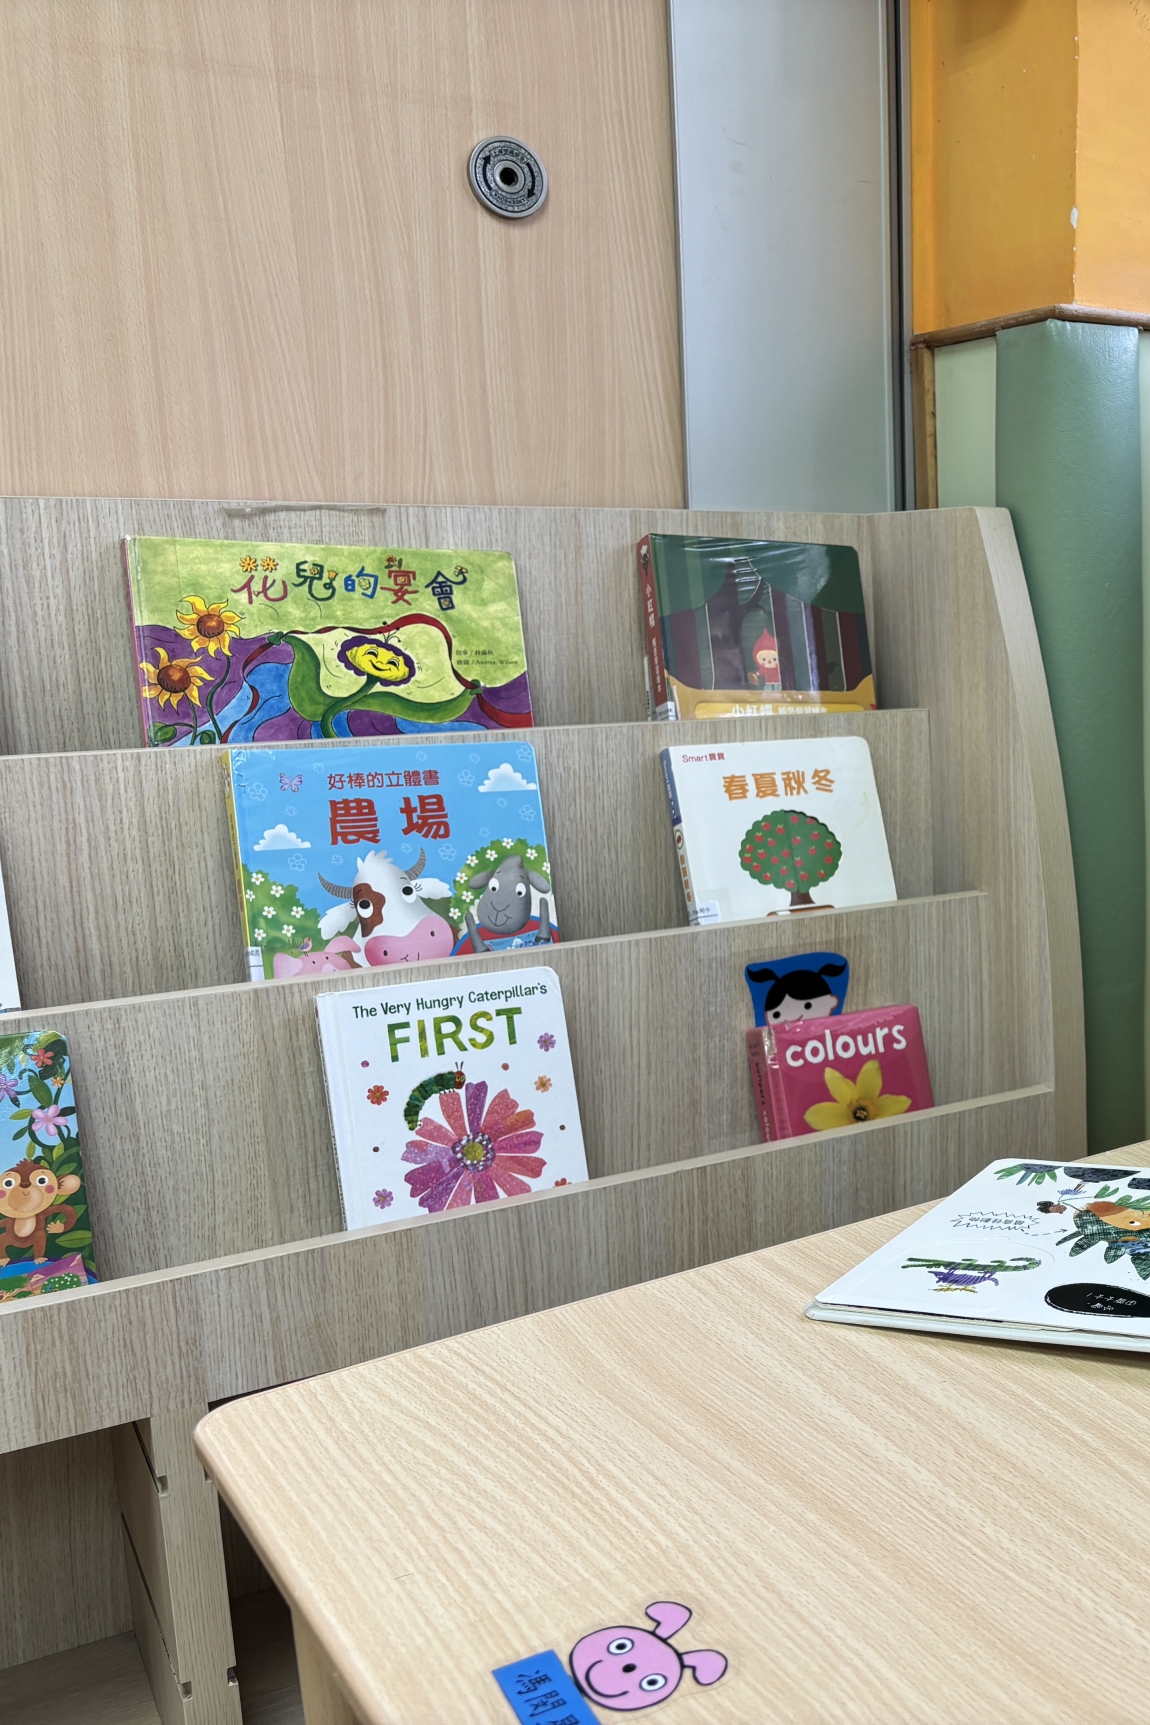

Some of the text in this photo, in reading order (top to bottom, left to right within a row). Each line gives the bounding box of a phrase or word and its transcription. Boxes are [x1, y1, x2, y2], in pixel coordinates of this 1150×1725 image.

[230, 555, 468, 611] 花兒的宴會
[327, 769, 440, 791] 好棒的立體書
[722, 768, 836, 801] 春夏秋冬
[329, 794, 451, 846] 農場
[351, 982, 548, 1019] The Very Hungry Caterpillar's
[387, 1006, 522, 1063] FIRST
[785, 1024, 907, 1068] colours
[762, 1110, 771, 1142] colou
